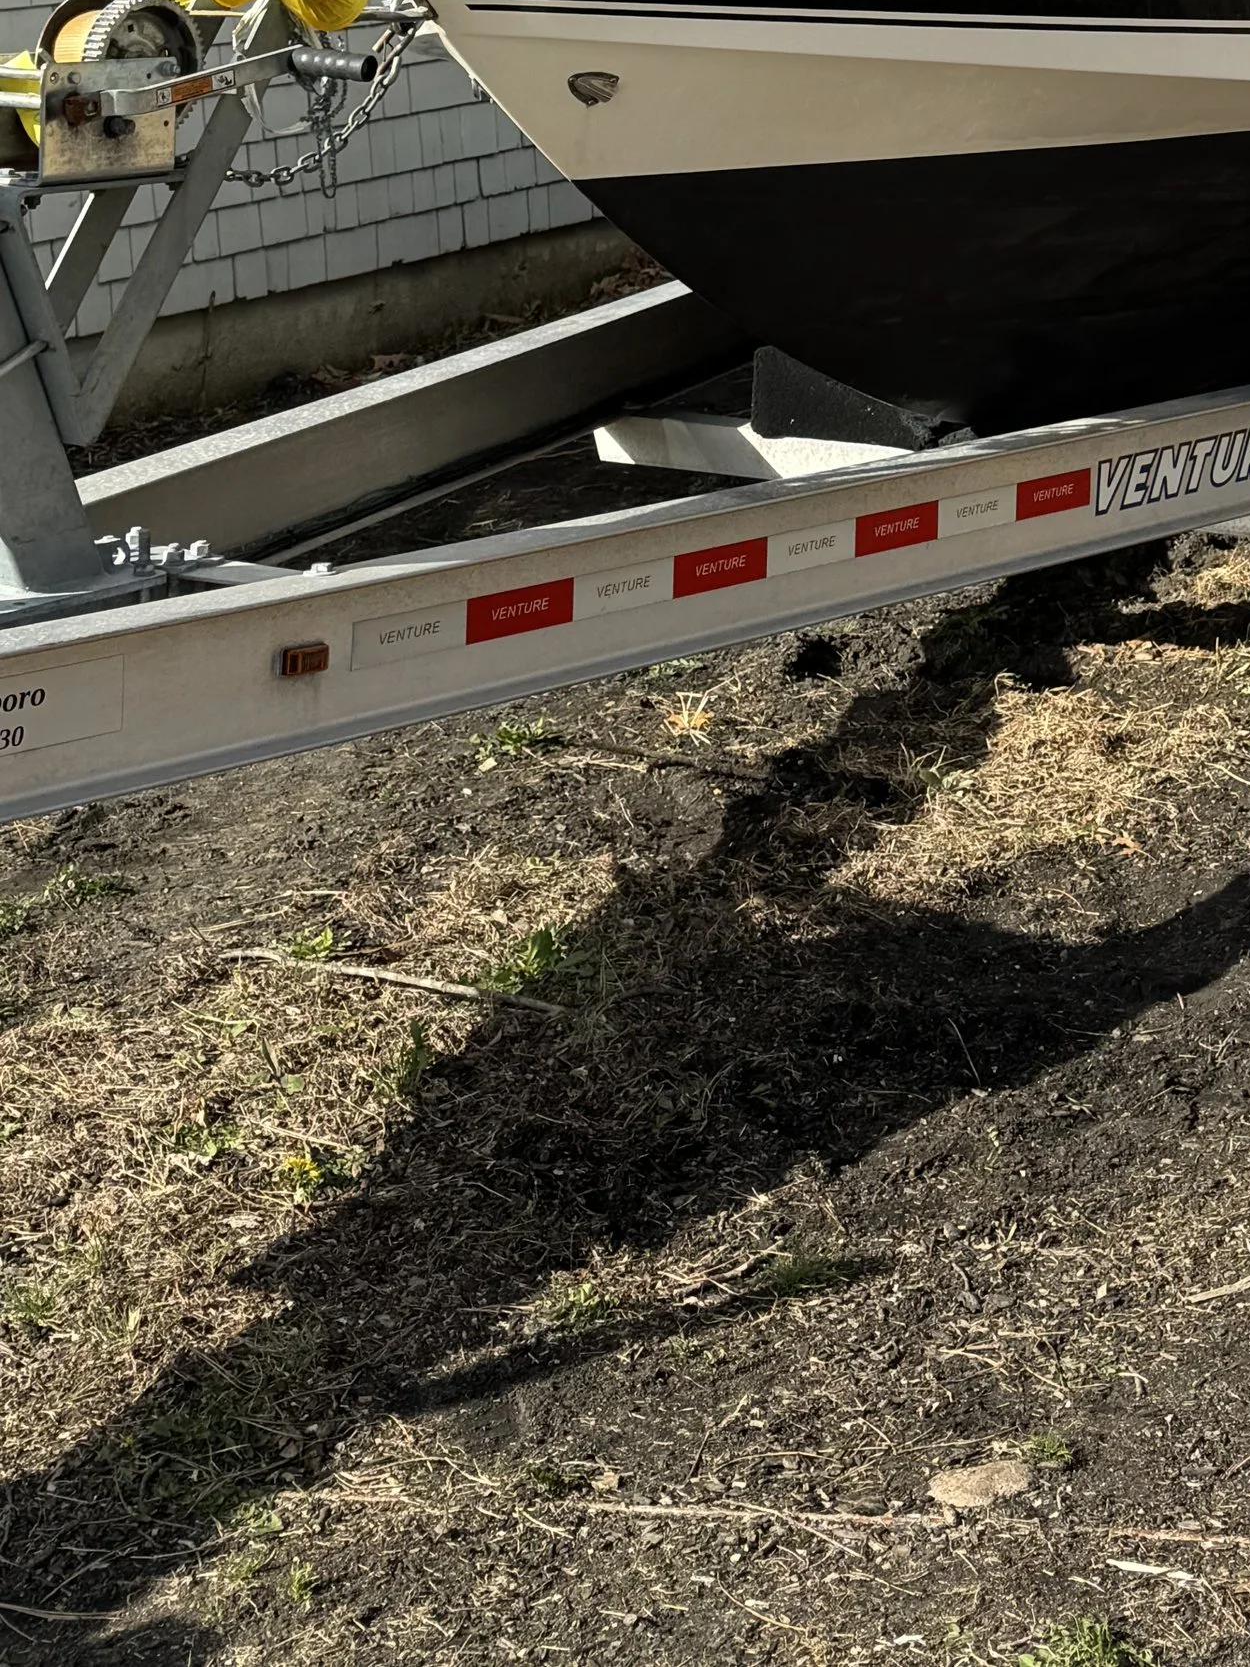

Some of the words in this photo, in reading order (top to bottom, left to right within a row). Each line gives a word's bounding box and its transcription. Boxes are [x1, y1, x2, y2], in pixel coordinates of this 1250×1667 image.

[378, 620, 441, 645] VENTURE
[491, 597, 550, 621] VENTURE
[596, 575, 651, 598] VENTURE
[695, 554, 747, 577] VENTURE
[787, 535, 836, 556] VENTURE
[874, 516, 921, 537] VENTURE
[956, 499, 999, 519] VENTURE
[1033, 483, 1075, 503] VENTURE
[0, 688, 46, 712] oro
